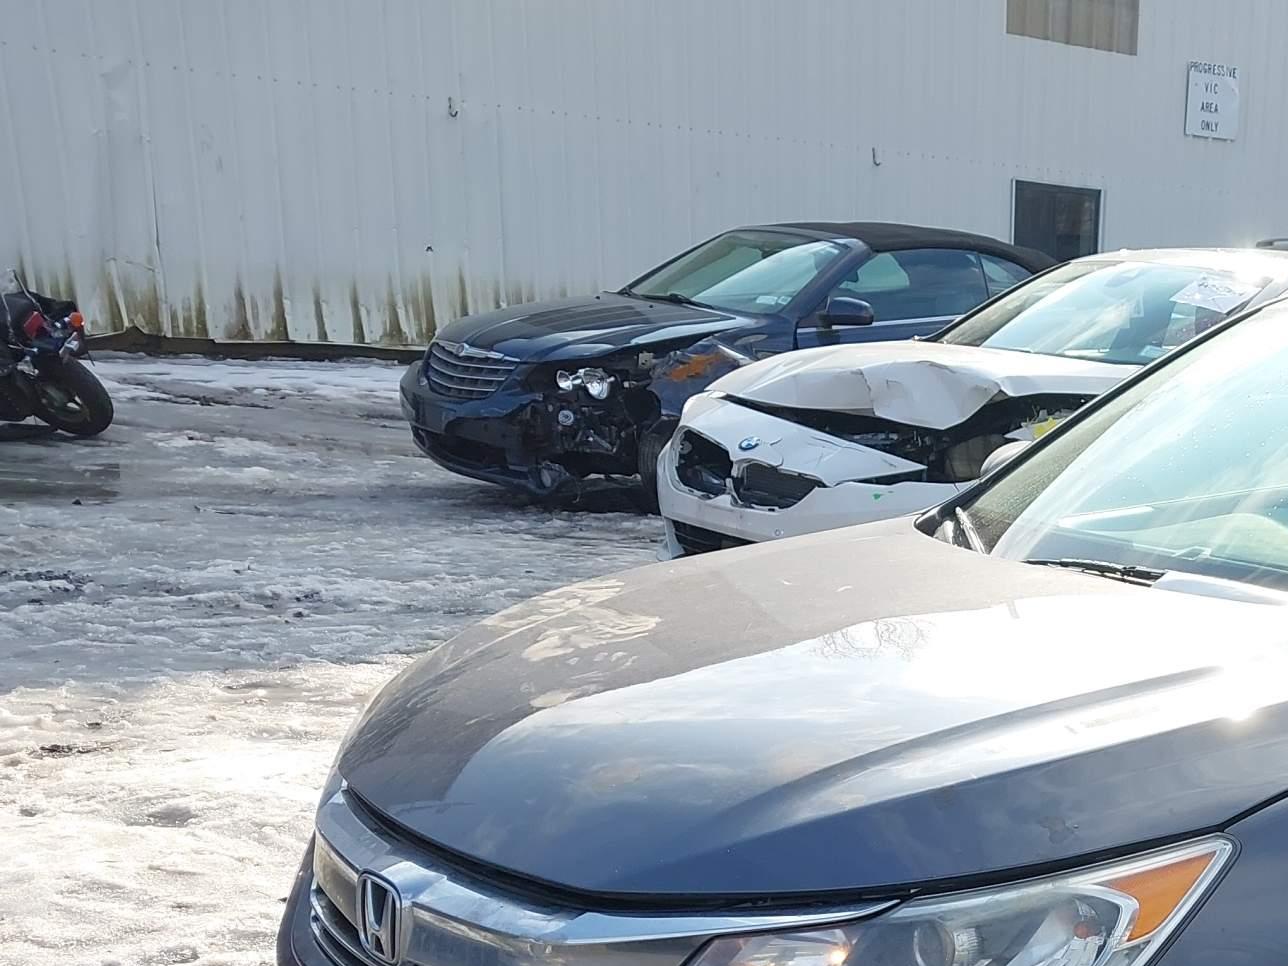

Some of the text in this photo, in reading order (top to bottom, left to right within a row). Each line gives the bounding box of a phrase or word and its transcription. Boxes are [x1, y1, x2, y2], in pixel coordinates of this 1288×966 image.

[1189, 61, 1237, 79] PROGRESSIVE
[1204, 82, 1219, 94] VIC
[1200, 101, 1219, 113] AREA
[1200, 119, 1219, 132] ONLY
